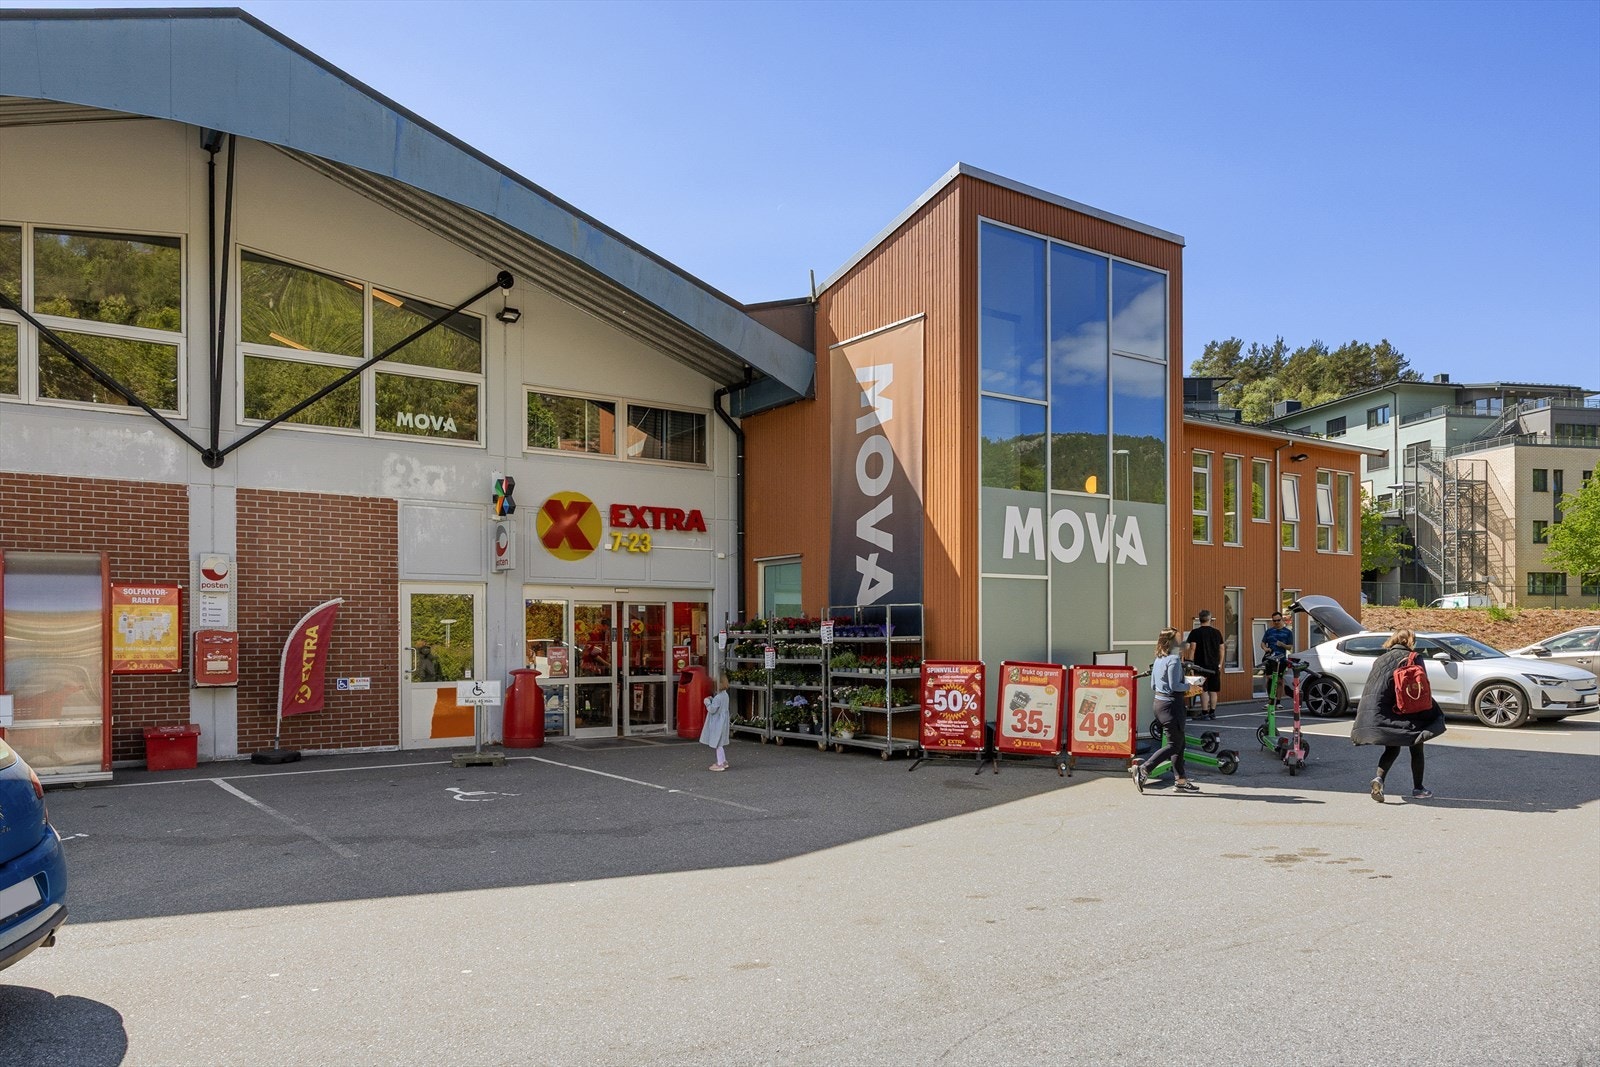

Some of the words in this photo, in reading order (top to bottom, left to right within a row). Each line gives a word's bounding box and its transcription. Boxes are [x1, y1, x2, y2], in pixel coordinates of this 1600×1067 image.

[396, 412, 457, 433] MOVA
[855, 363, 894, 607] MOVA
[609, 504, 706, 532] EXTRA
[610, 531, 652, 553] 7-23
[1002, 505, 1148, 566] MOVA
[123, 588, 168, 596] SOLFAKTOR-
[302, 625, 319, 682] EXTRA
[926, 689, 977, 712] -50%
